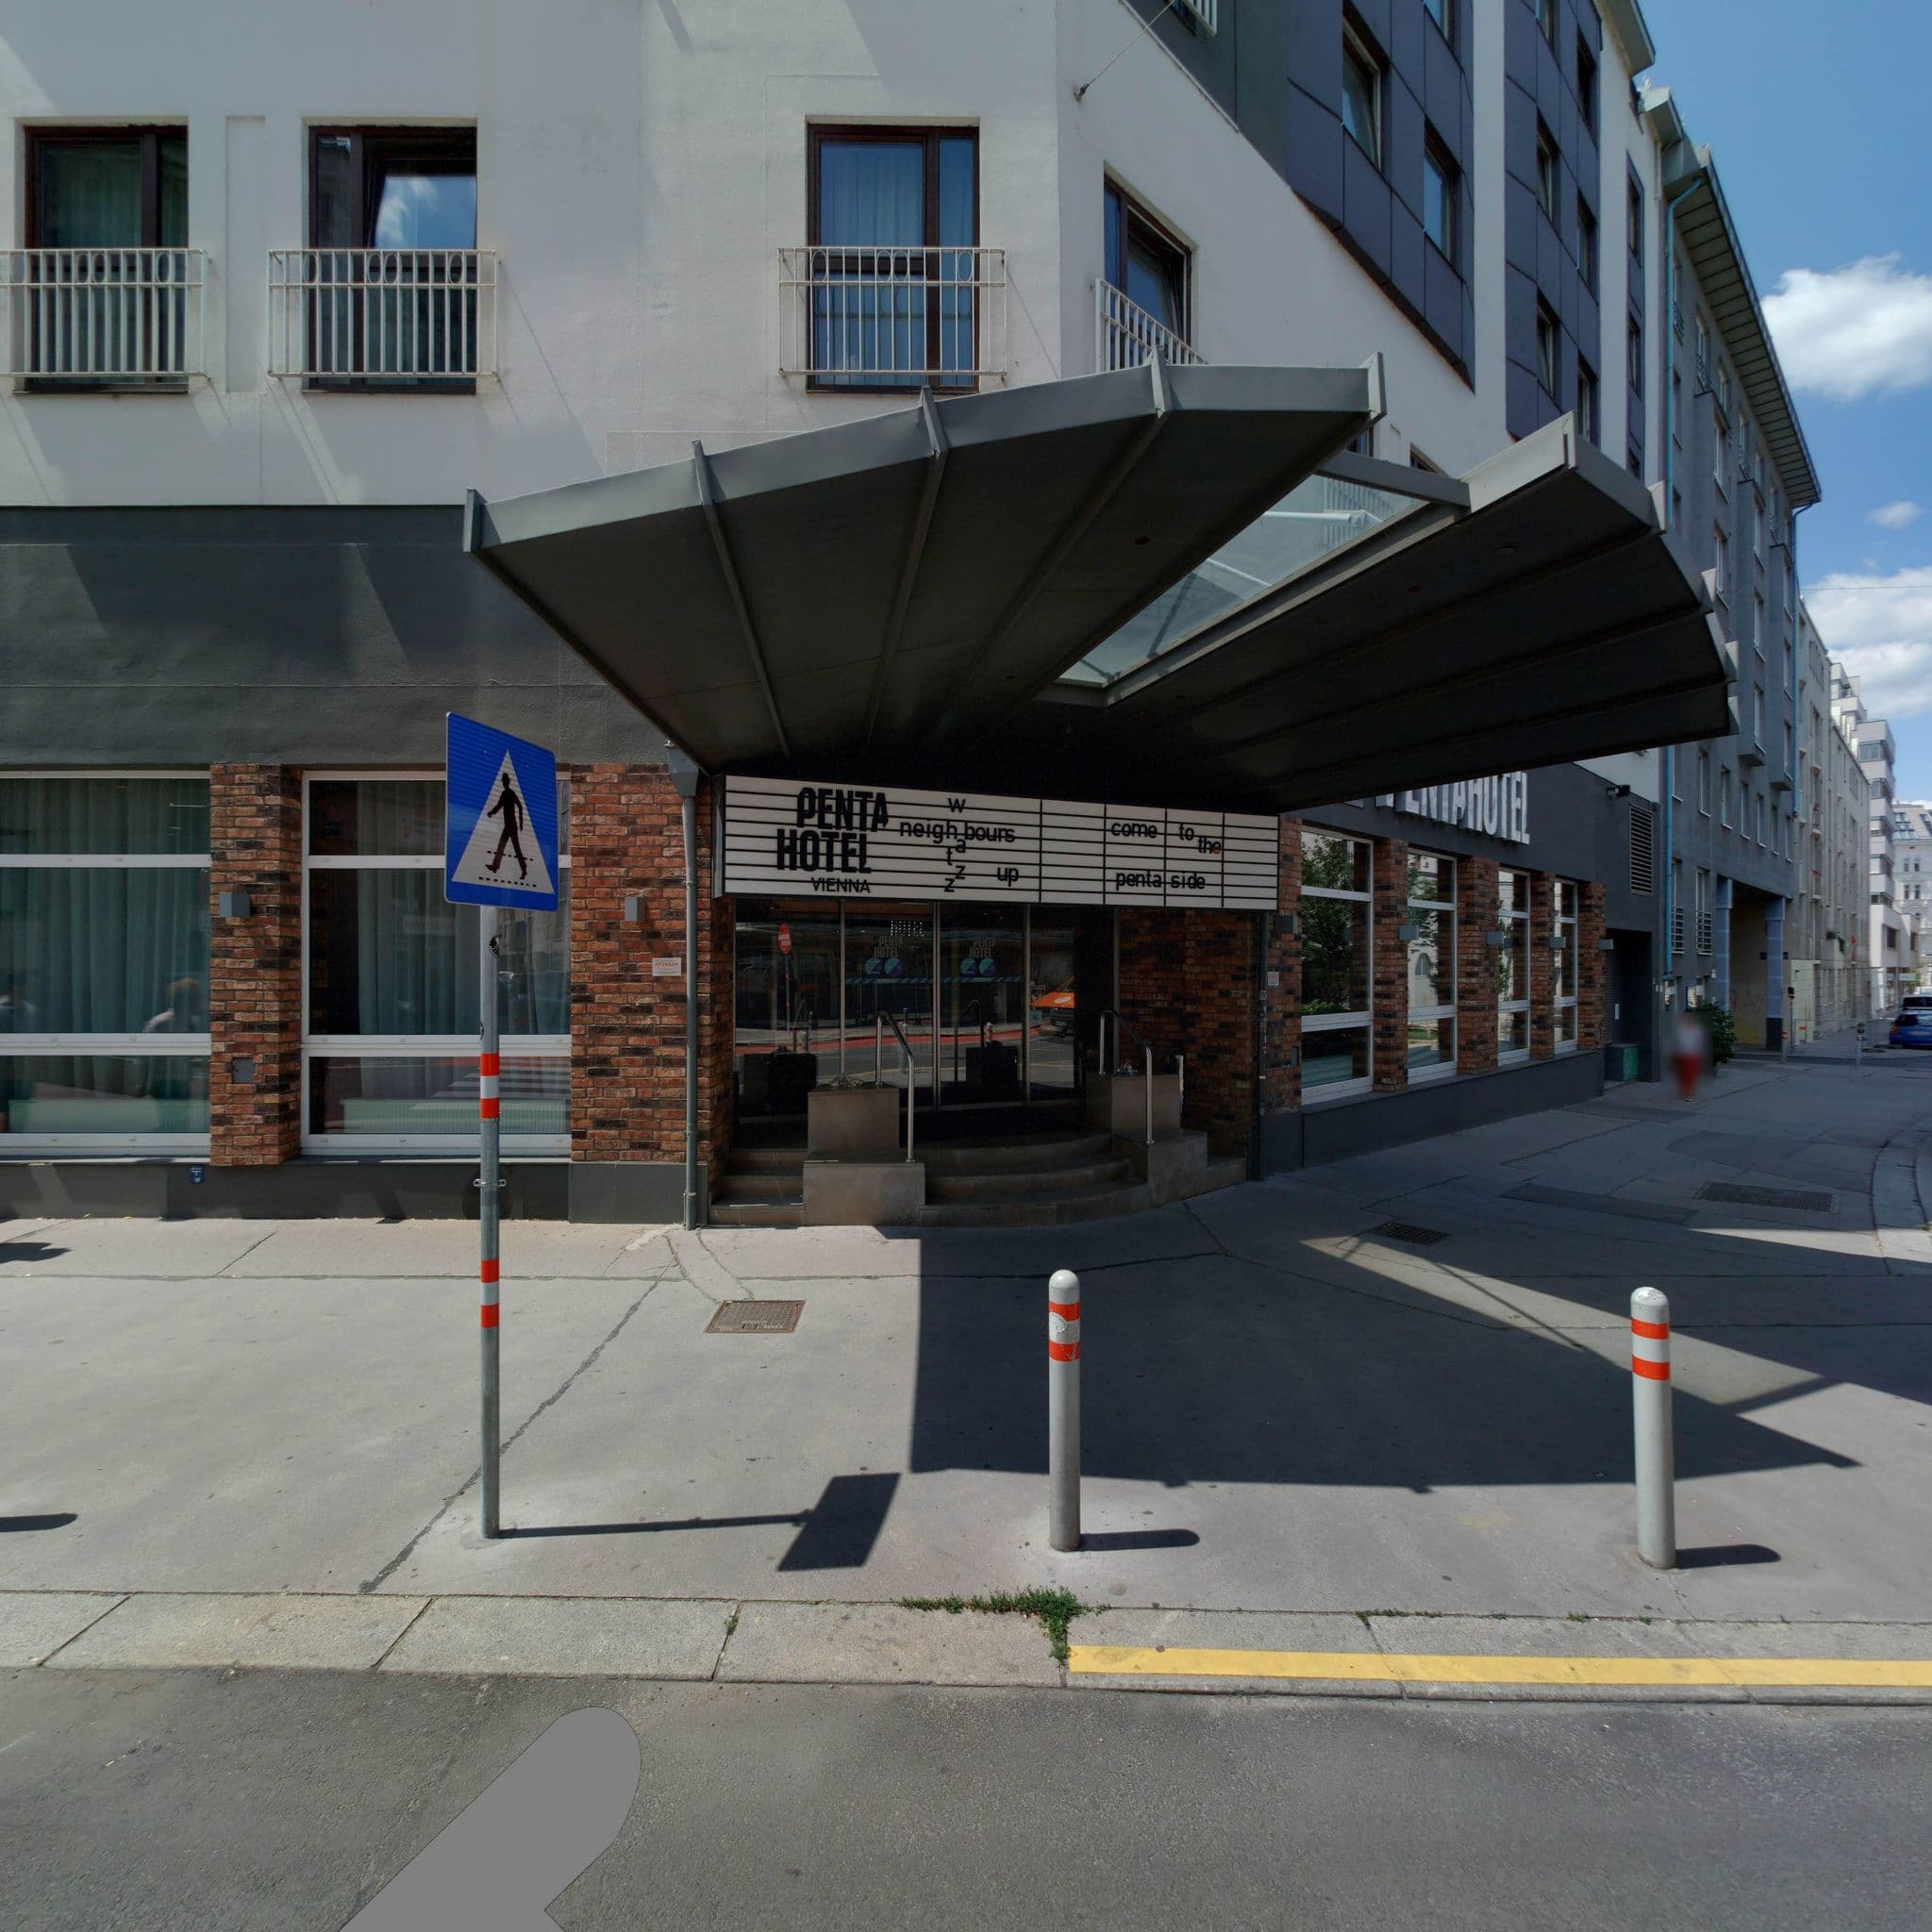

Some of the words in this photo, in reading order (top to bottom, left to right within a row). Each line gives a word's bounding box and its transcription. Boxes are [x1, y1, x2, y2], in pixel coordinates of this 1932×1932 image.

[797, 787, 889, 832] PENTA
[1375, 770, 1530, 844] TAHOTEL
[1111, 822, 1158, 839] come
[1179, 823, 1195, 841] to
[776, 828, 872, 874] HOTEL
[1198, 836, 1222, 854] the
[811, 877, 871, 893] VIENNA
[996, 867, 1019, 887] up
[1116, 870, 1162, 891] penta
[1171, 871, 1206, 890] side
